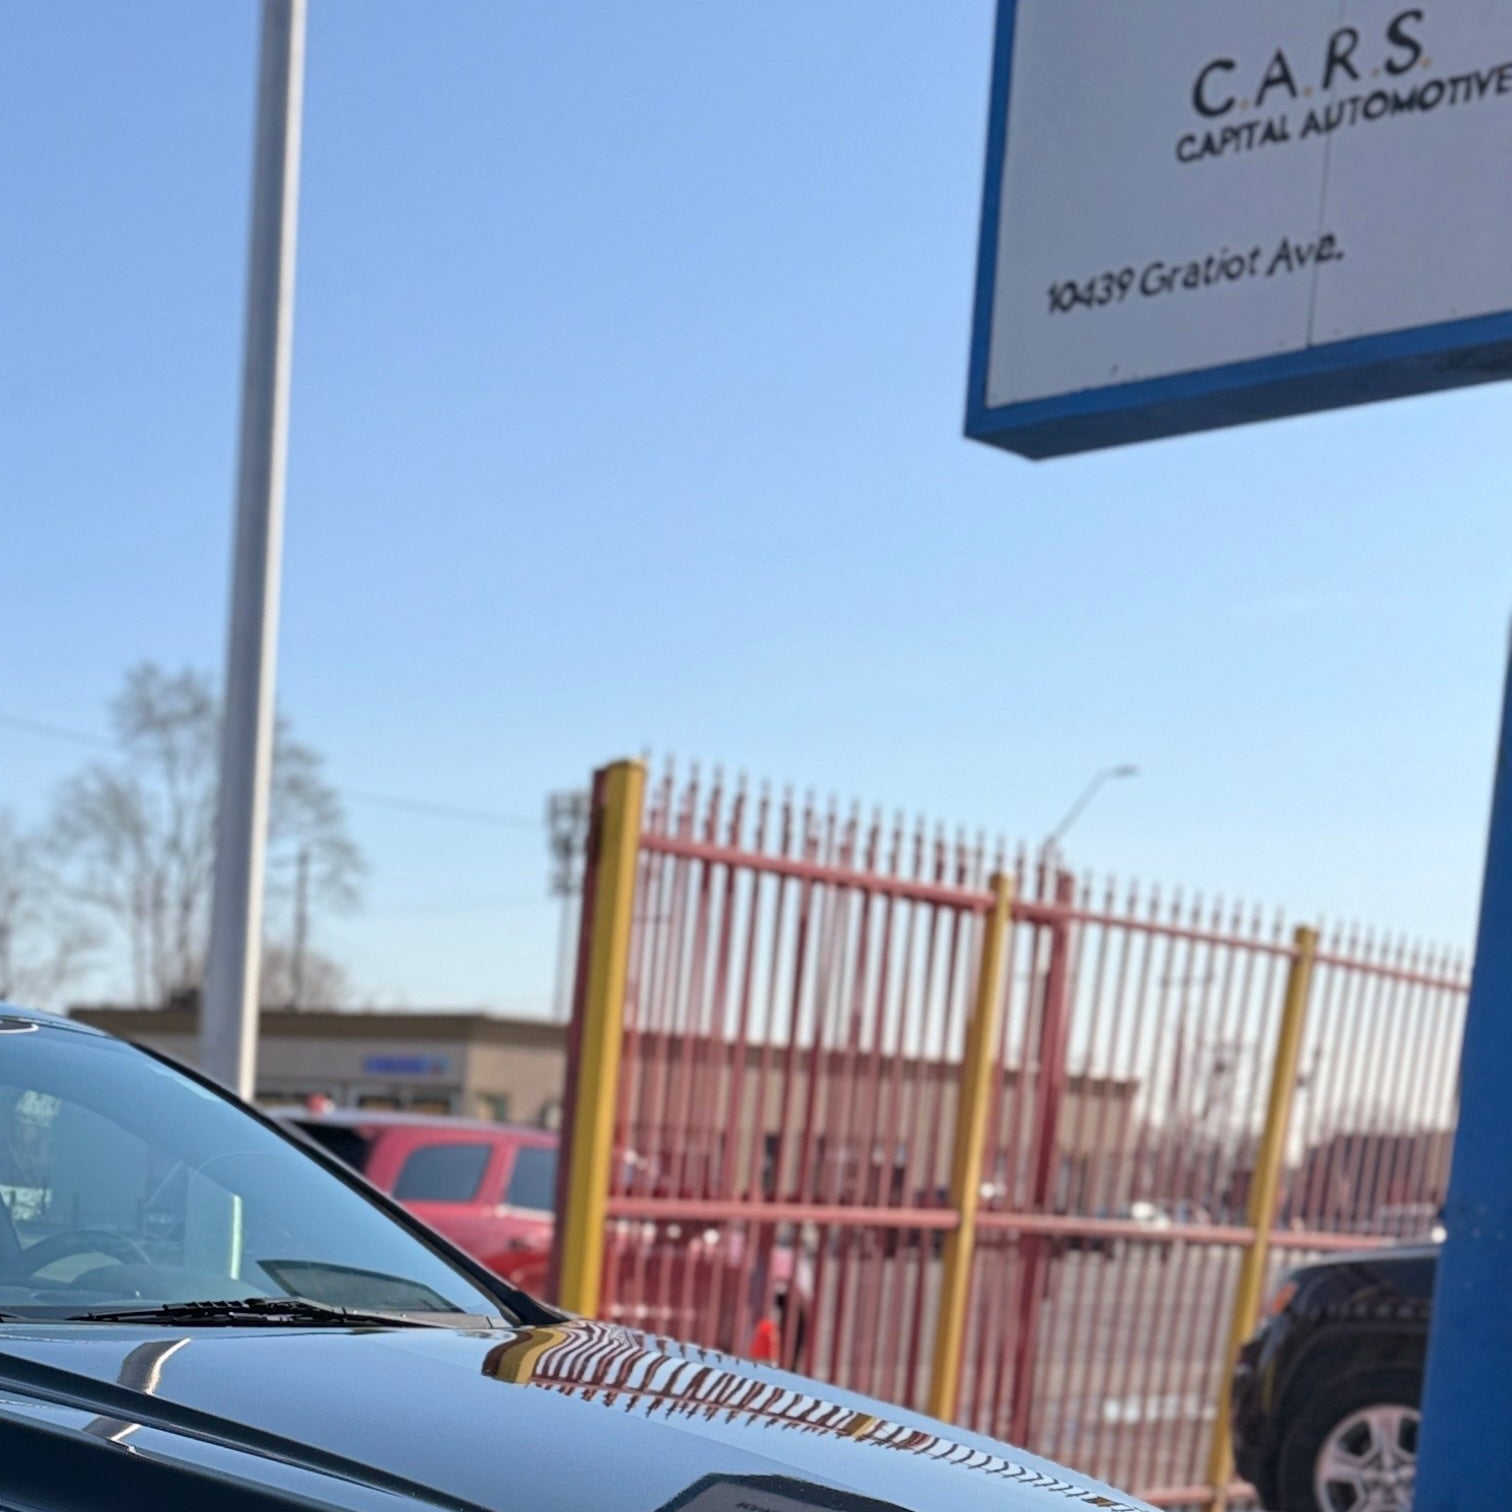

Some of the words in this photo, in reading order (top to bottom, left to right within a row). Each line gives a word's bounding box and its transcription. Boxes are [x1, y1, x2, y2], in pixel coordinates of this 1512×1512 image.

[1175, 114, 1291, 164] CAPITAL
[1299, 61, 1512, 139] AUTOMOTIVE
[1047, 264, 1135, 316] 10439
[1139, 245, 1261, 299] Gratiot
[1264, 232, 1345, 277] Ave.
